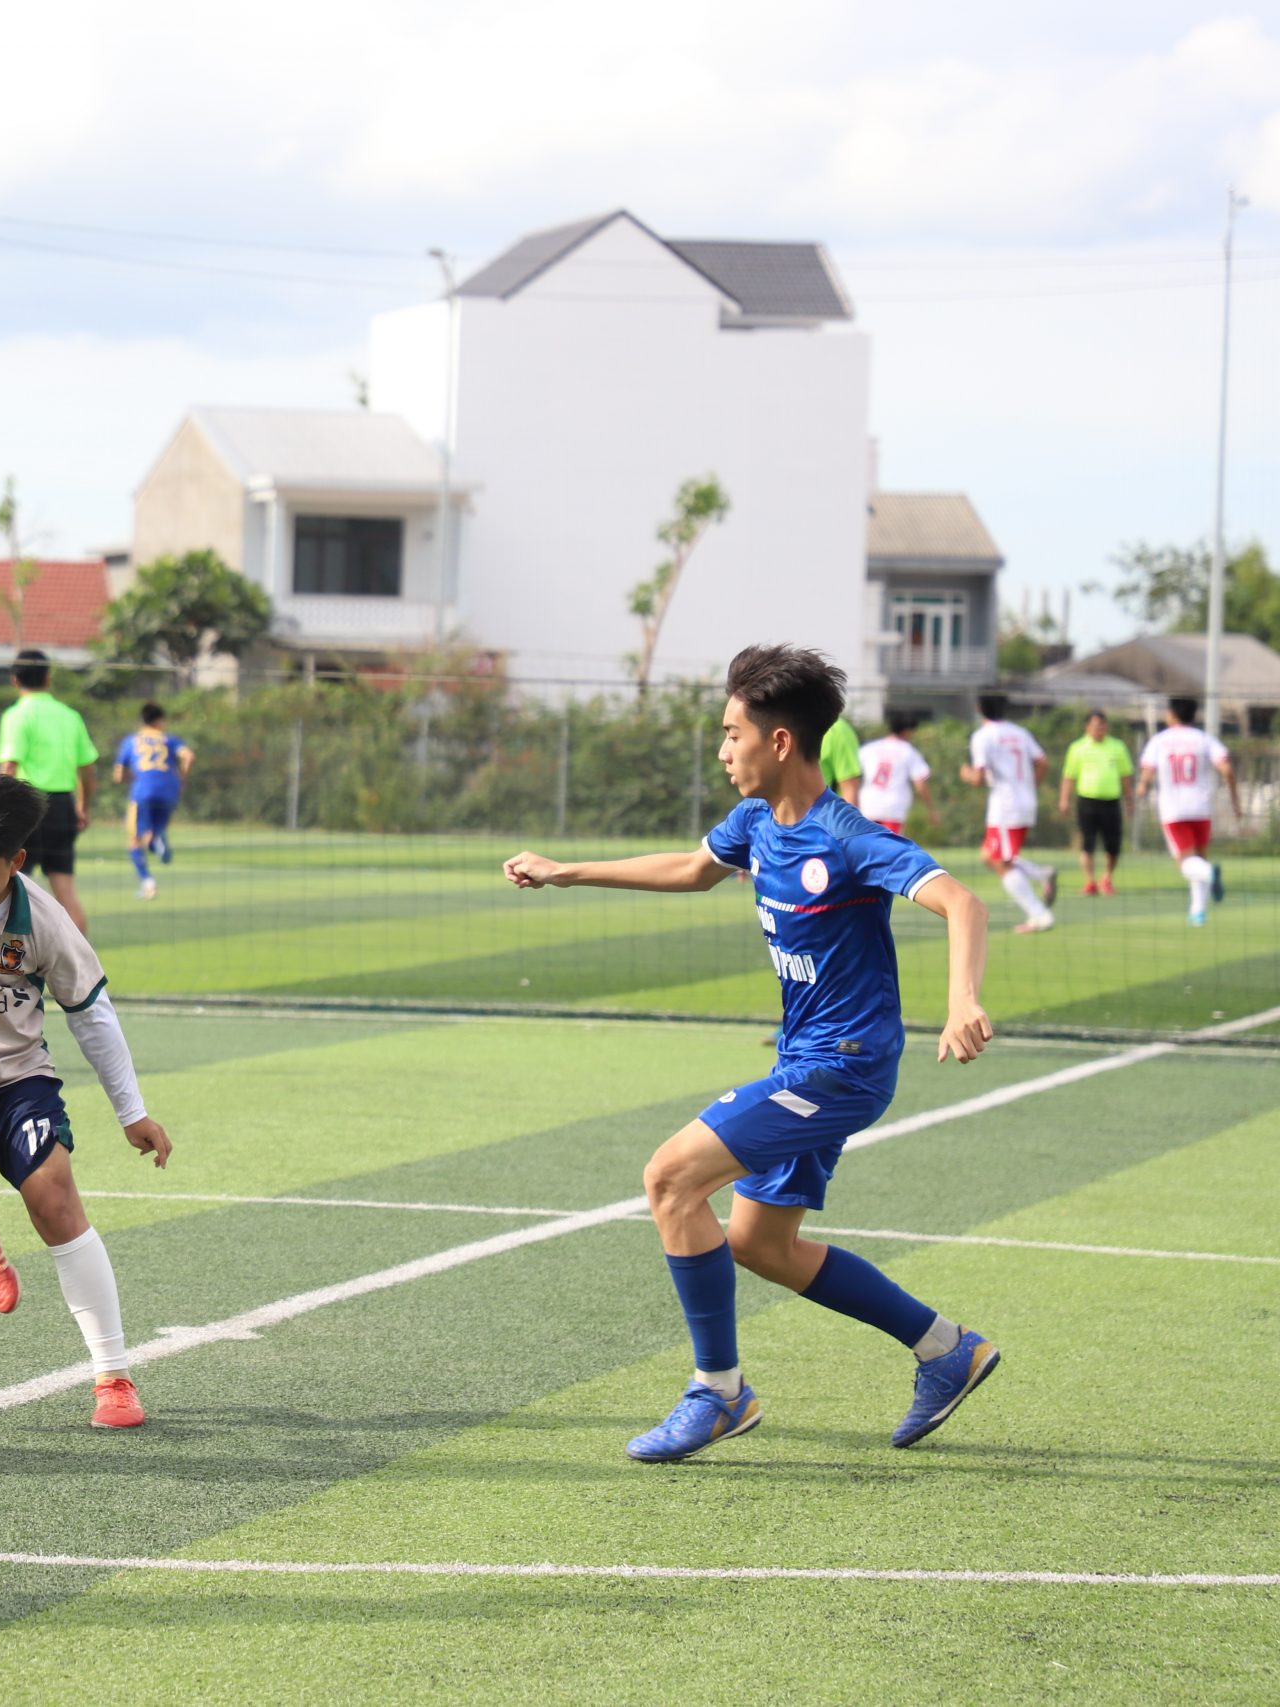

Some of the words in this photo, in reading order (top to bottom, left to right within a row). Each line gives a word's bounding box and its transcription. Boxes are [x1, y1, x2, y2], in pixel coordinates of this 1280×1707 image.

[139, 743, 169, 773] 22
[1167, 752, 1197, 786] 10
[22, 1117, 51, 1157] 17
